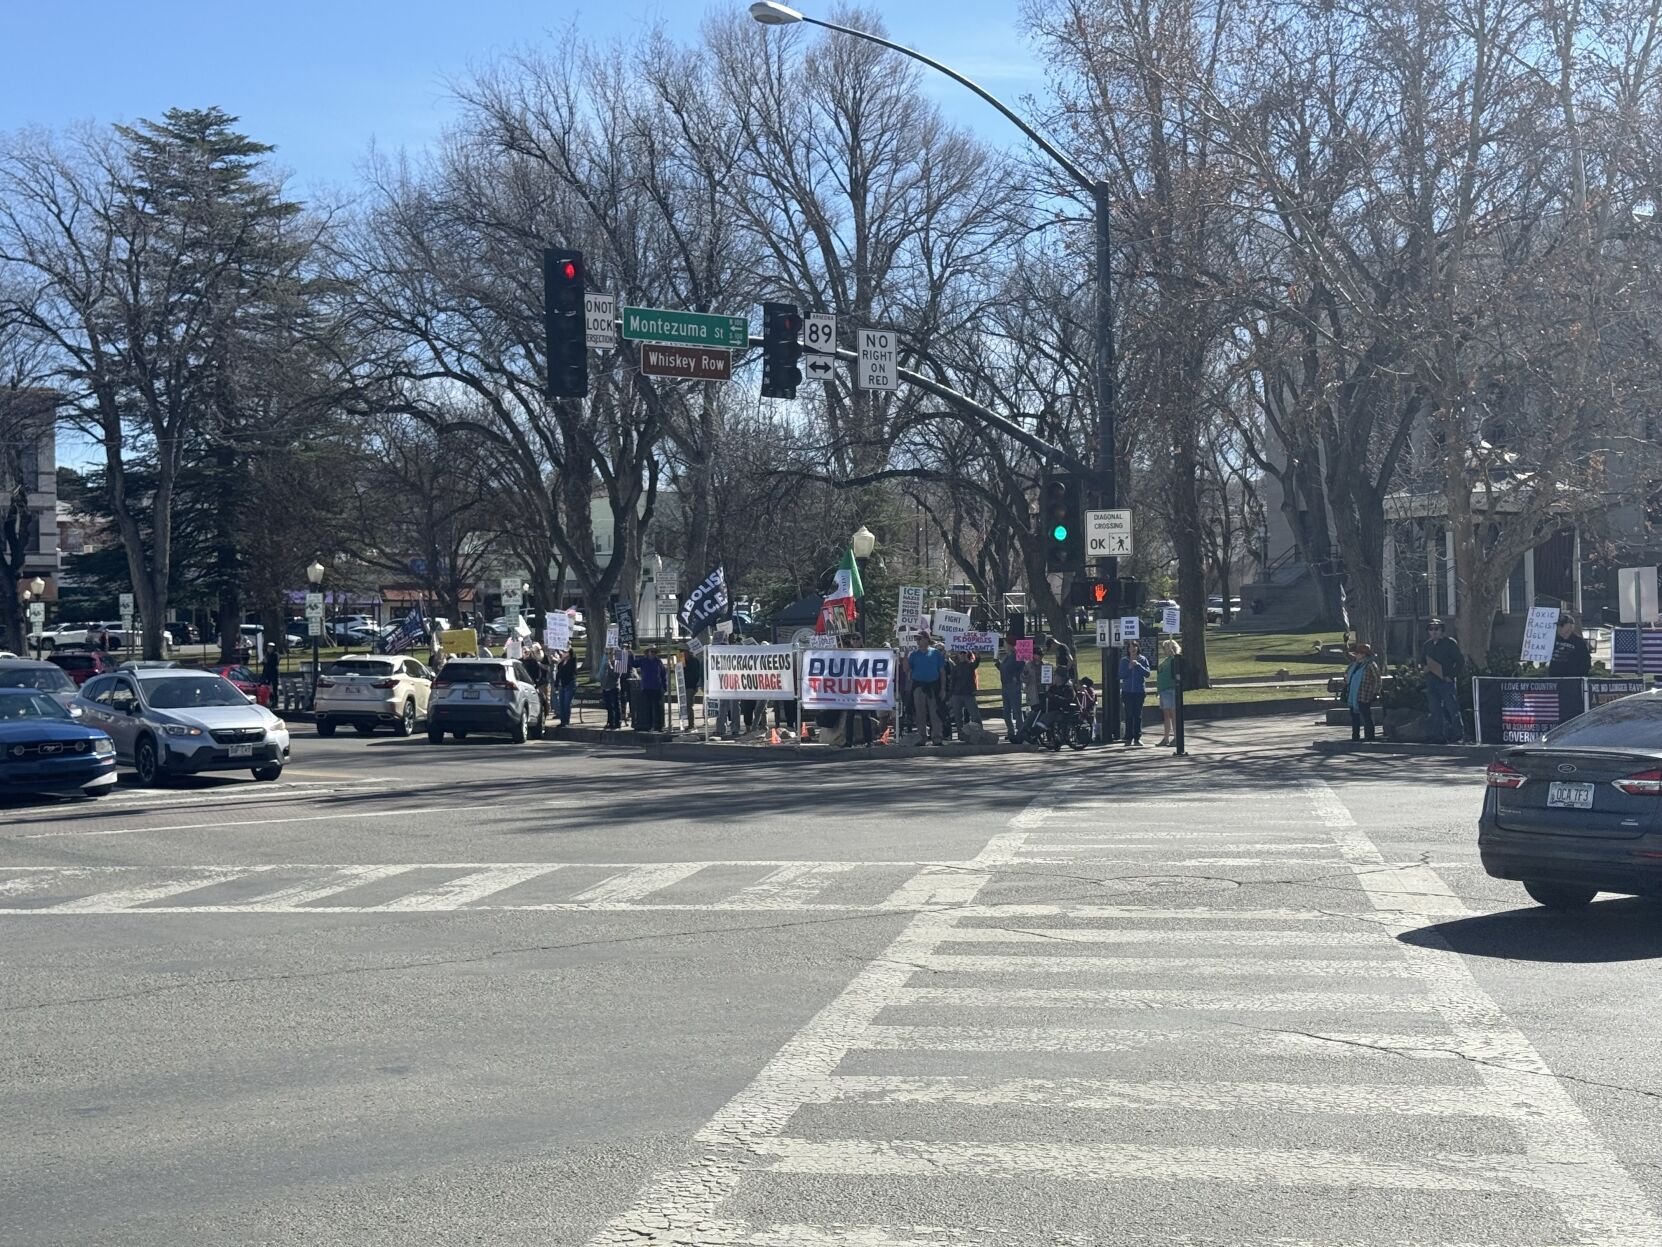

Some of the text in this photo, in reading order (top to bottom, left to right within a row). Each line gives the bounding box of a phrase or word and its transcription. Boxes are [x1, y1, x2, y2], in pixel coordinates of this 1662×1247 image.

[594, 300, 614, 315] NOT
[586, 318, 613, 332] LOCK
[630, 315, 724, 339] Montezuma St
[808, 323, 832, 344] 89
[866, 333, 888, 348] NO
[862, 349, 893, 362] RIGHT
[648, 351, 725, 372] Whiskey Row
[870, 363, 886, 373] ON
[868, 375, 889, 386] RED
[1094, 513, 1123, 521] DIAGONAL
[1094, 522, 1124, 530] CROSSING
[1090, 538, 1106, 550] OK
[903, 587, 920, 596] ICE
[944, 614, 961, 624] FIGHT
[1530, 608, 1555, 619] TOXIC
[901, 617, 918, 625] OUT
[1527, 618, 1556, 629] RACIST
[1526, 628, 1546, 639] UGLY
[1523, 640, 1546, 650] MEAN
[1522, 650, 1549, 661] PETTY
[710, 653, 791, 671] DEMOCRACY NEEDS
[808, 657, 888, 678] DUMP
[719, 673, 782, 691] YOUR COURAGE
[808, 678, 888, 695] TRUMP
[1504, 682, 1519, 690] LOVE
[1520, 682, 1530, 690] MY
[1530, 682, 1558, 690] COUNTRY
[1502, 723, 1512, 731] I'M
[1512, 723, 1540, 731] ASHAMED
